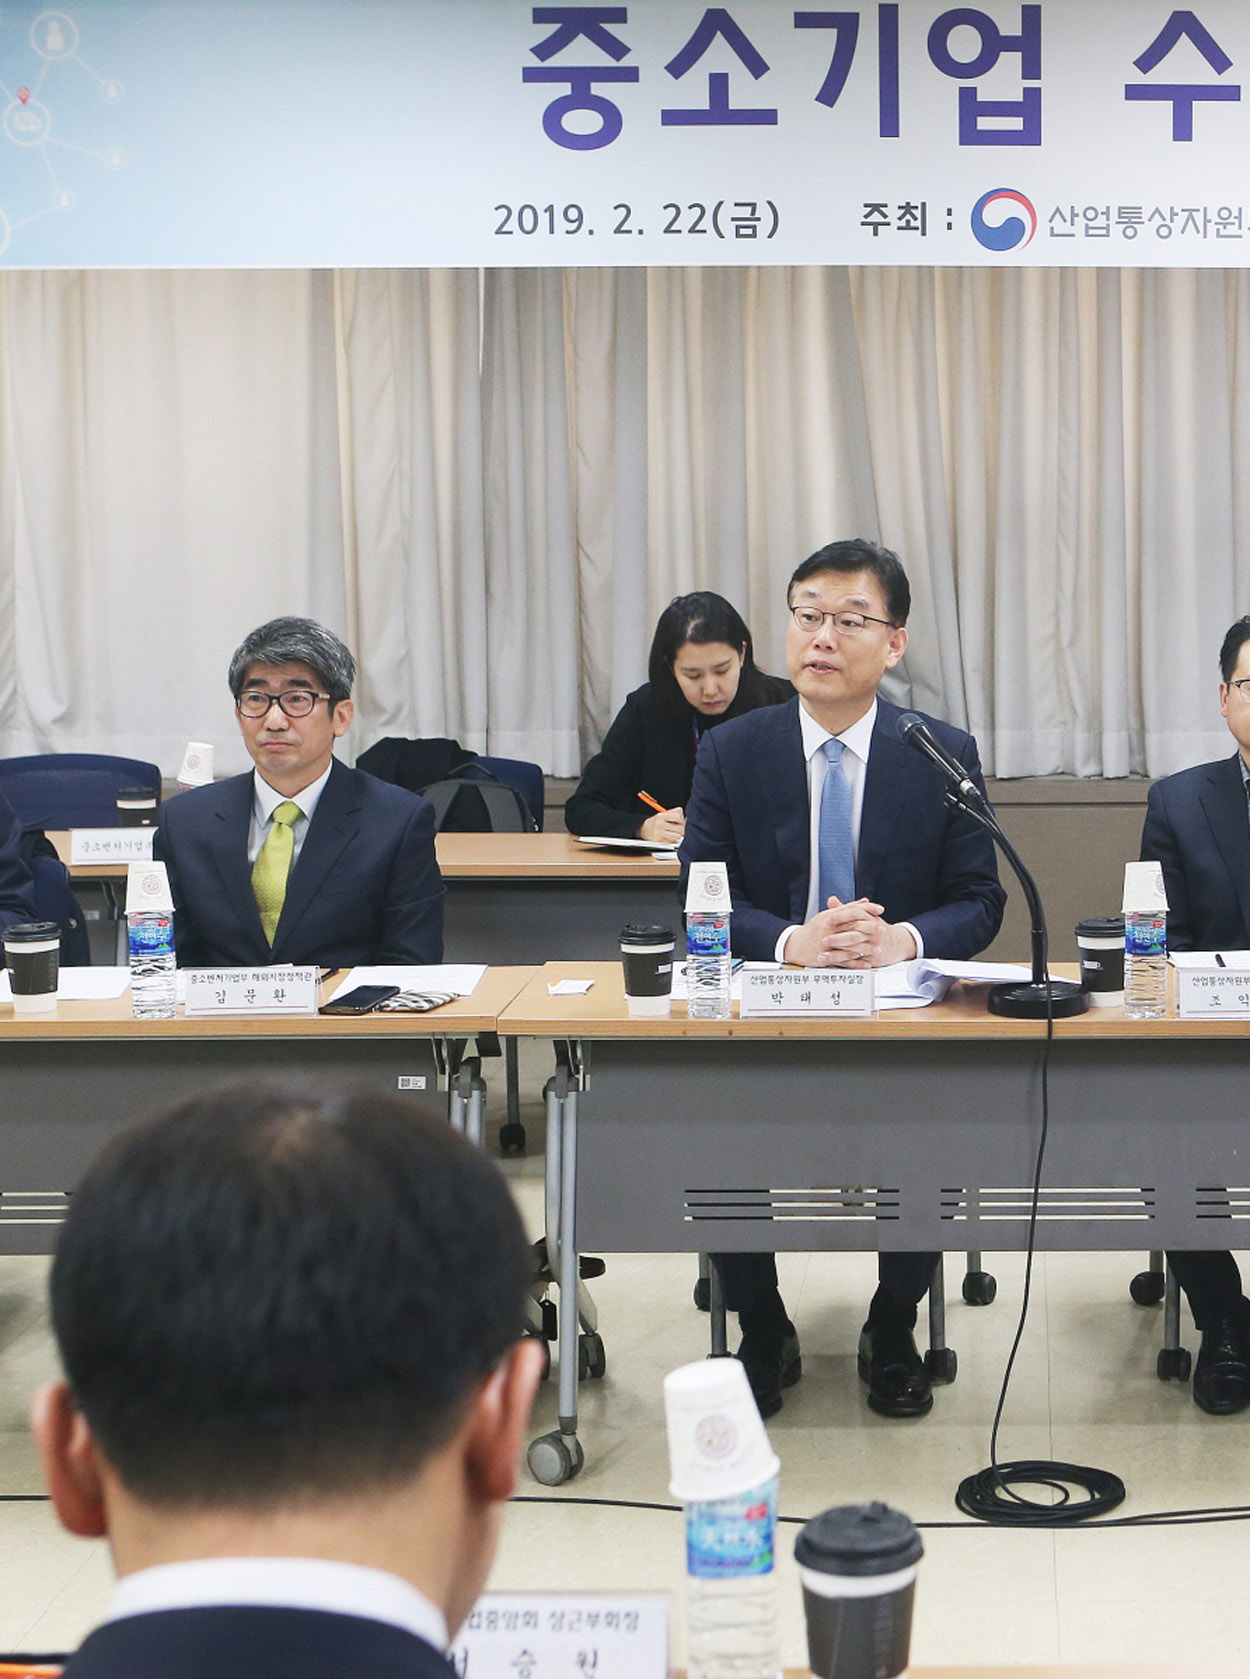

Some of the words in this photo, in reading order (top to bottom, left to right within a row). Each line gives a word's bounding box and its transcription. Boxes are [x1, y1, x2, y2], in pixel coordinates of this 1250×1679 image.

[522, 3, 1042, 151] 중소기업
[494, 203, 594, 236] 2019.
[612, 203, 644, 236] 2.
[663, 200, 780, 239] 22(금)
[190, 974, 248, 985] 중소벤처기업부
[750, 974, 810, 986] 산업통상자원부
[1191, 975, 1250, 987] 산업통상자원부
